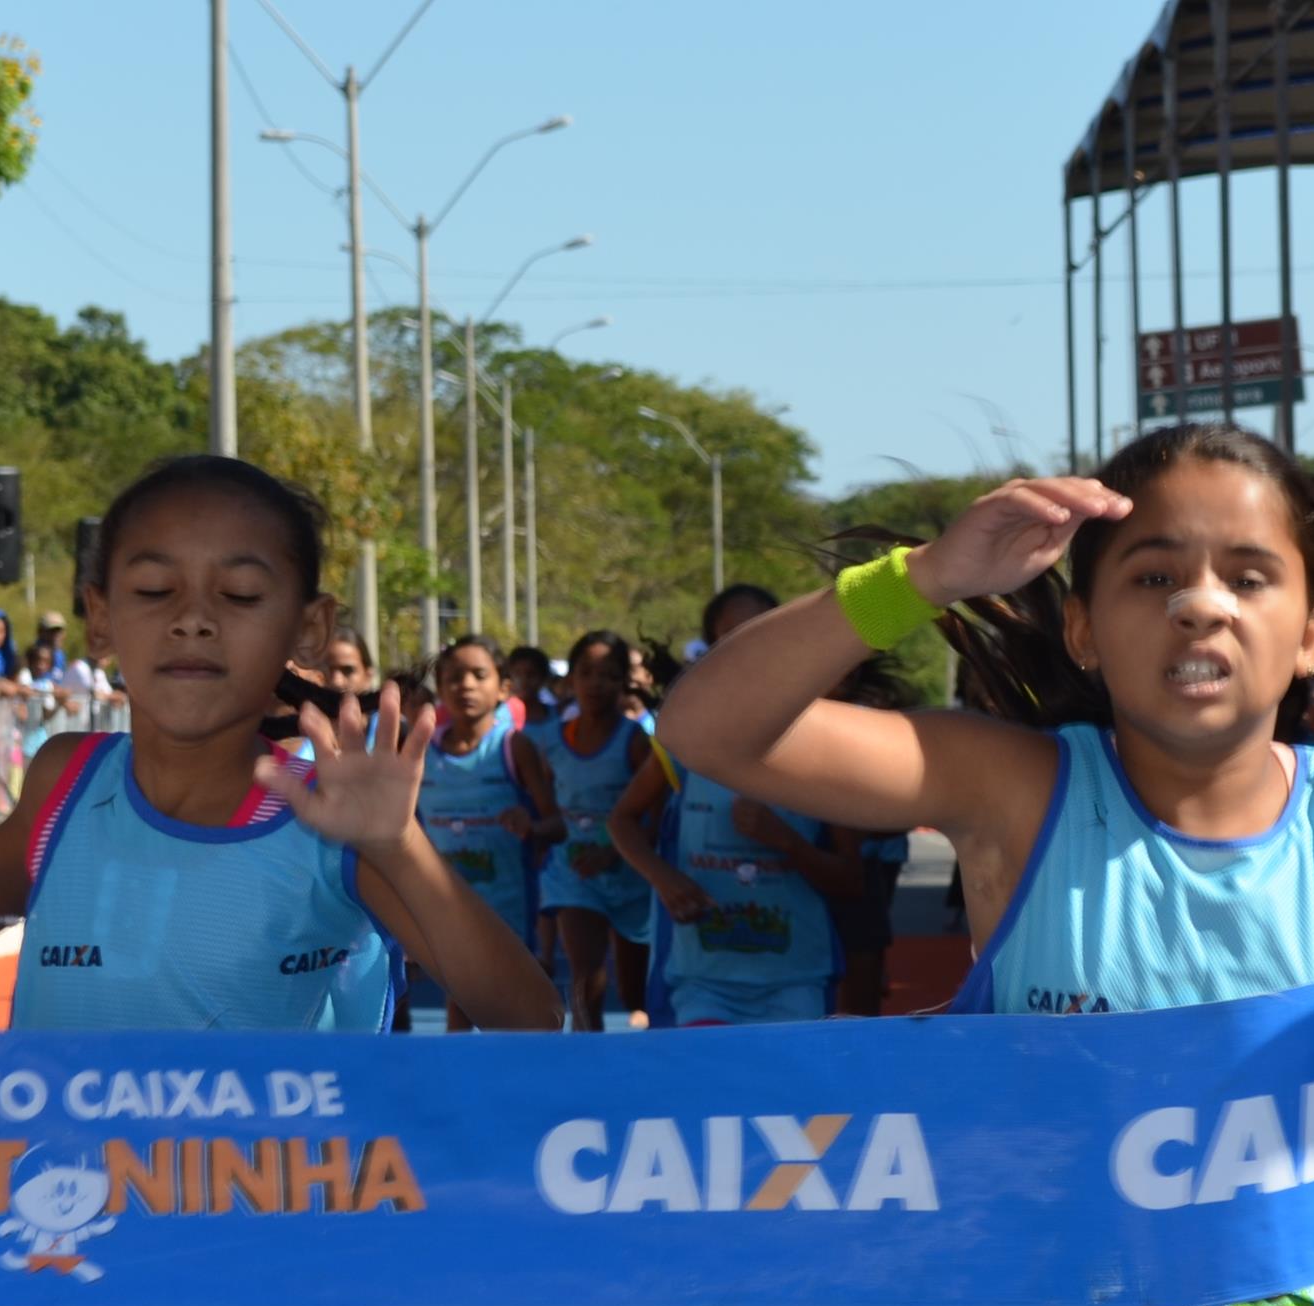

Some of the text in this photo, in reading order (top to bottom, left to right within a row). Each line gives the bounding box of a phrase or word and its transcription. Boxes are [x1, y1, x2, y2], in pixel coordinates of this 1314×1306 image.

[40, 944, 103, 967] CAIXA
[279, 946, 350, 976] CAIXA
[1027, 987, 1110, 1014] CAIXA
[64, 1068, 254, 1118] CAIXA
[269, 1070, 345, 1117] DE
[534, 1112, 940, 1216] CAIXA
